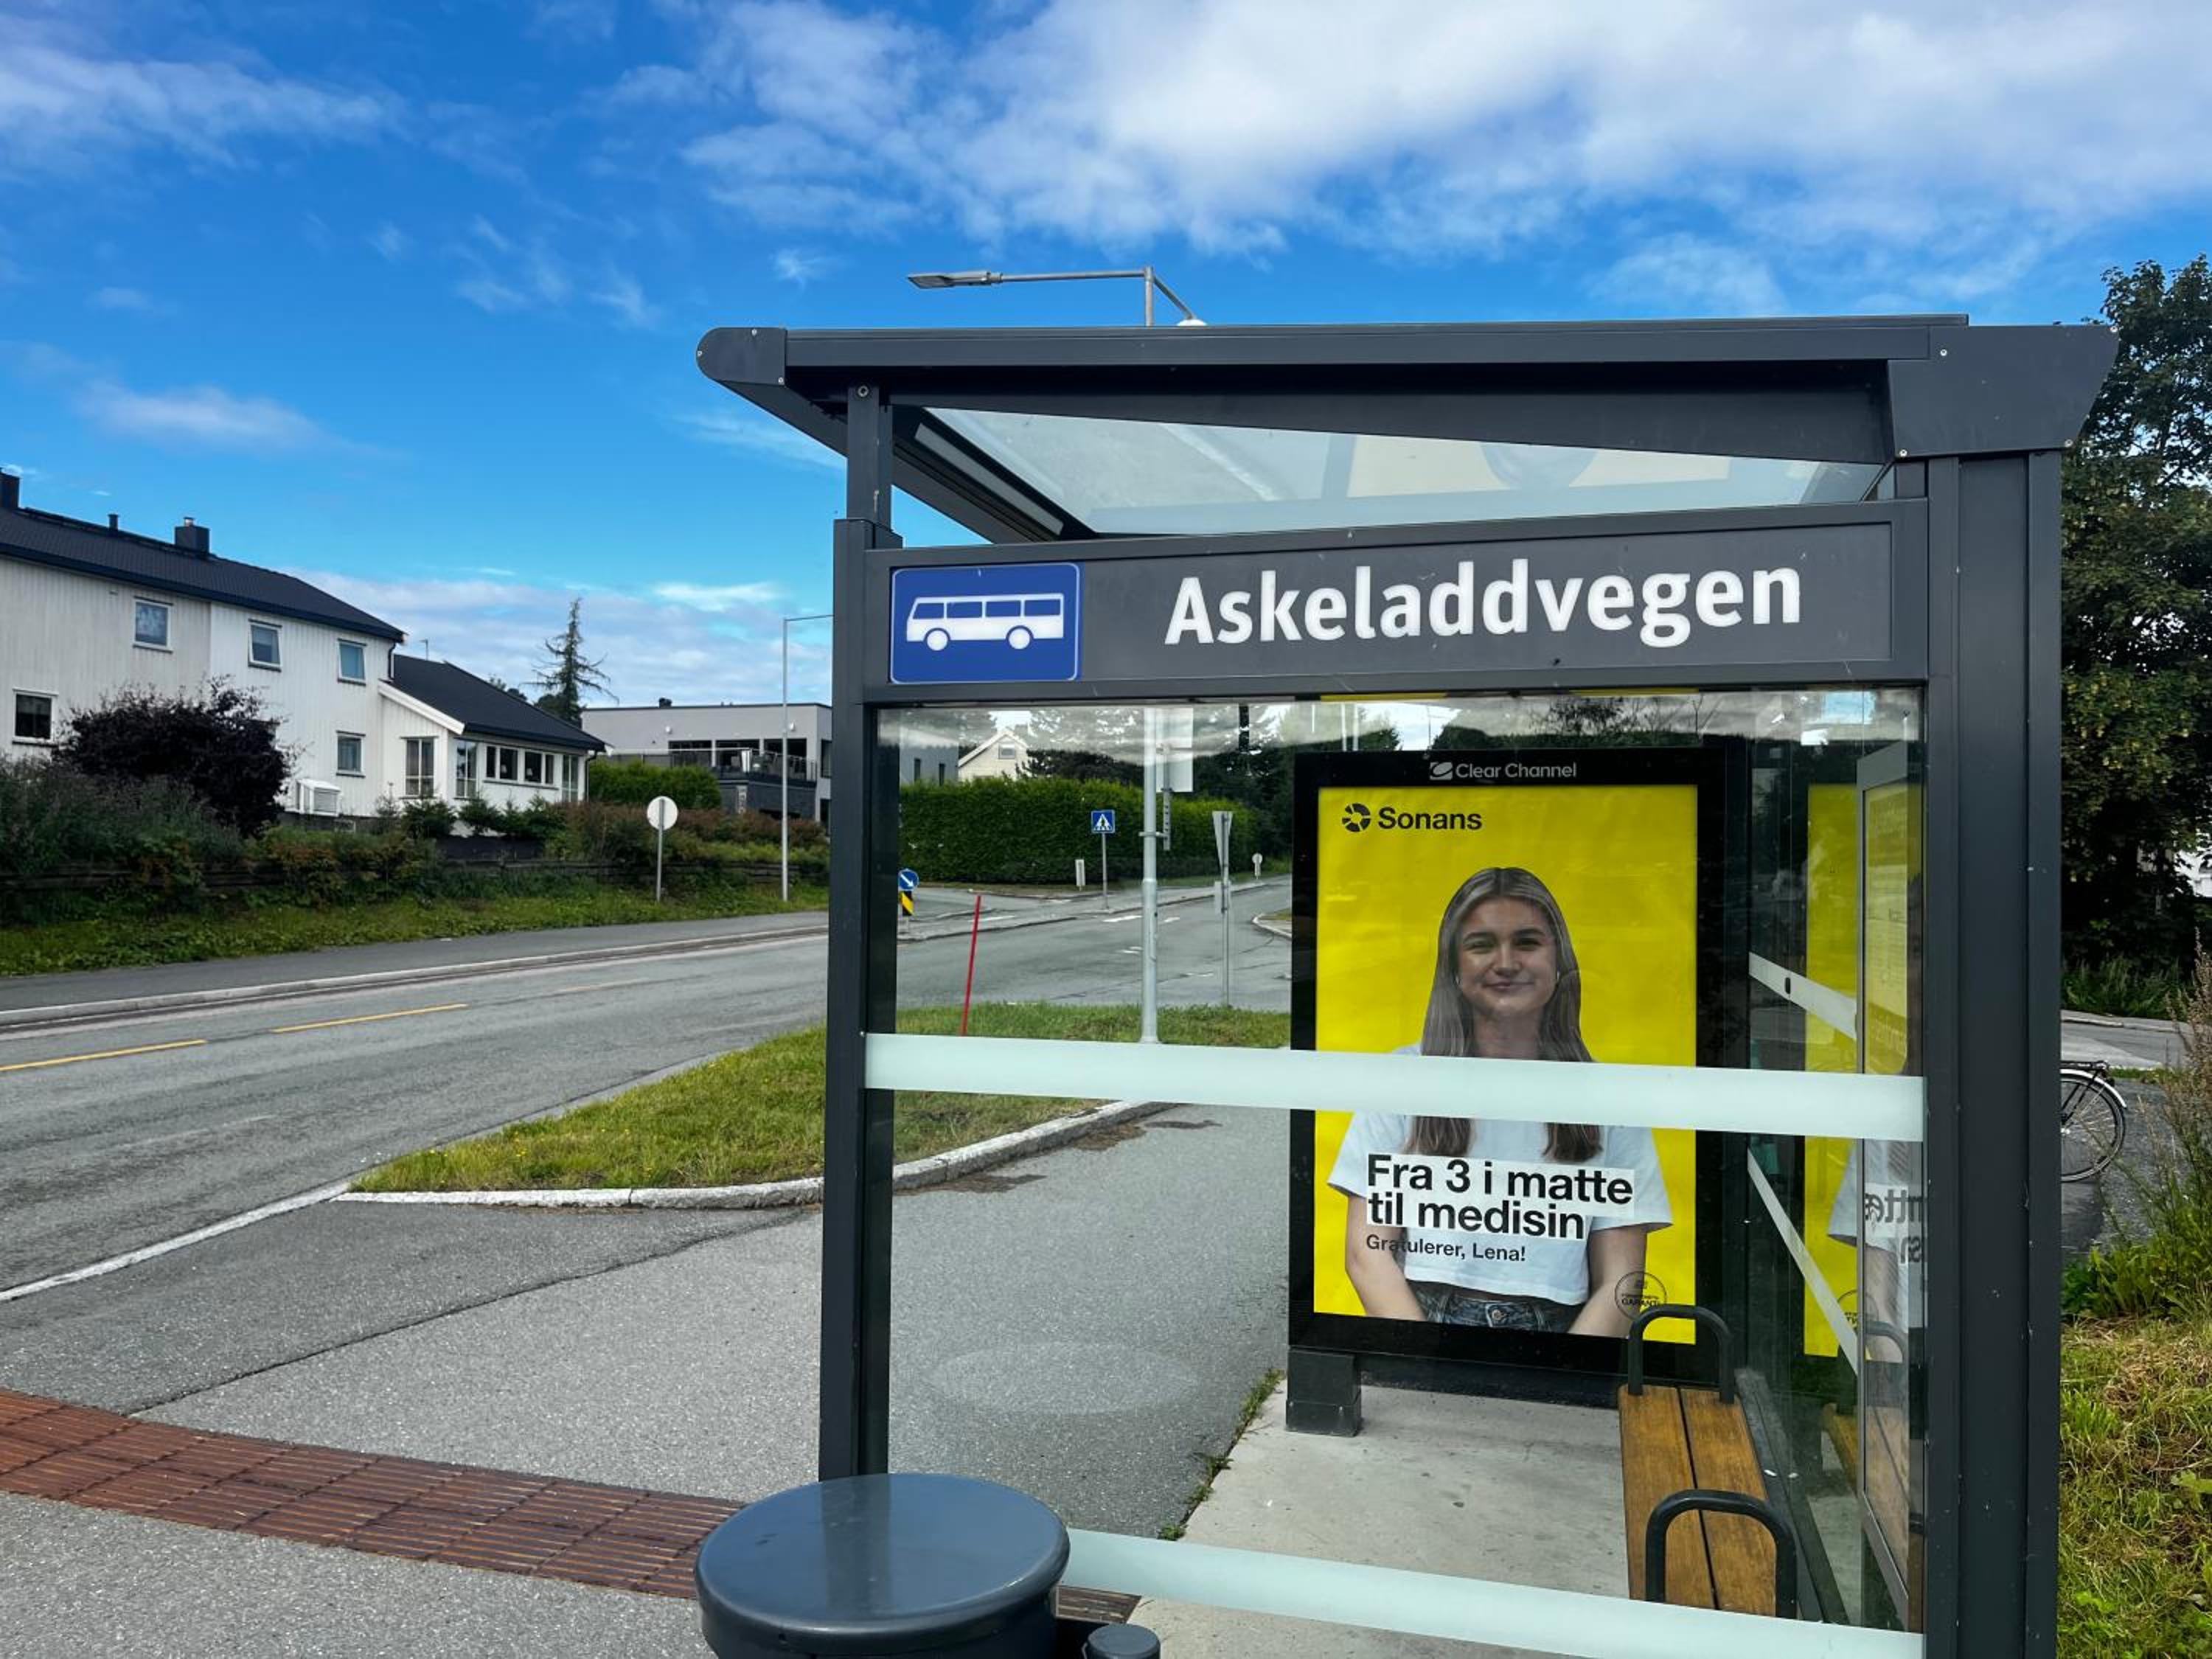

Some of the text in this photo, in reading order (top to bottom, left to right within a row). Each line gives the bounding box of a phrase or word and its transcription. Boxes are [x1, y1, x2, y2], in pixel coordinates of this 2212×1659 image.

[1164, 558, 1801, 648] Askeladdvegen
[1455, 762, 1577, 779] Clear Channel
[1378, 806, 1482, 830] Sonans
[1368, 1153, 1633, 1205] Fra 3 i matte
[1368, 1192, 1584, 1239] til medisin
[1366, 1234, 1526, 1262] Gratulerer, Lena!
